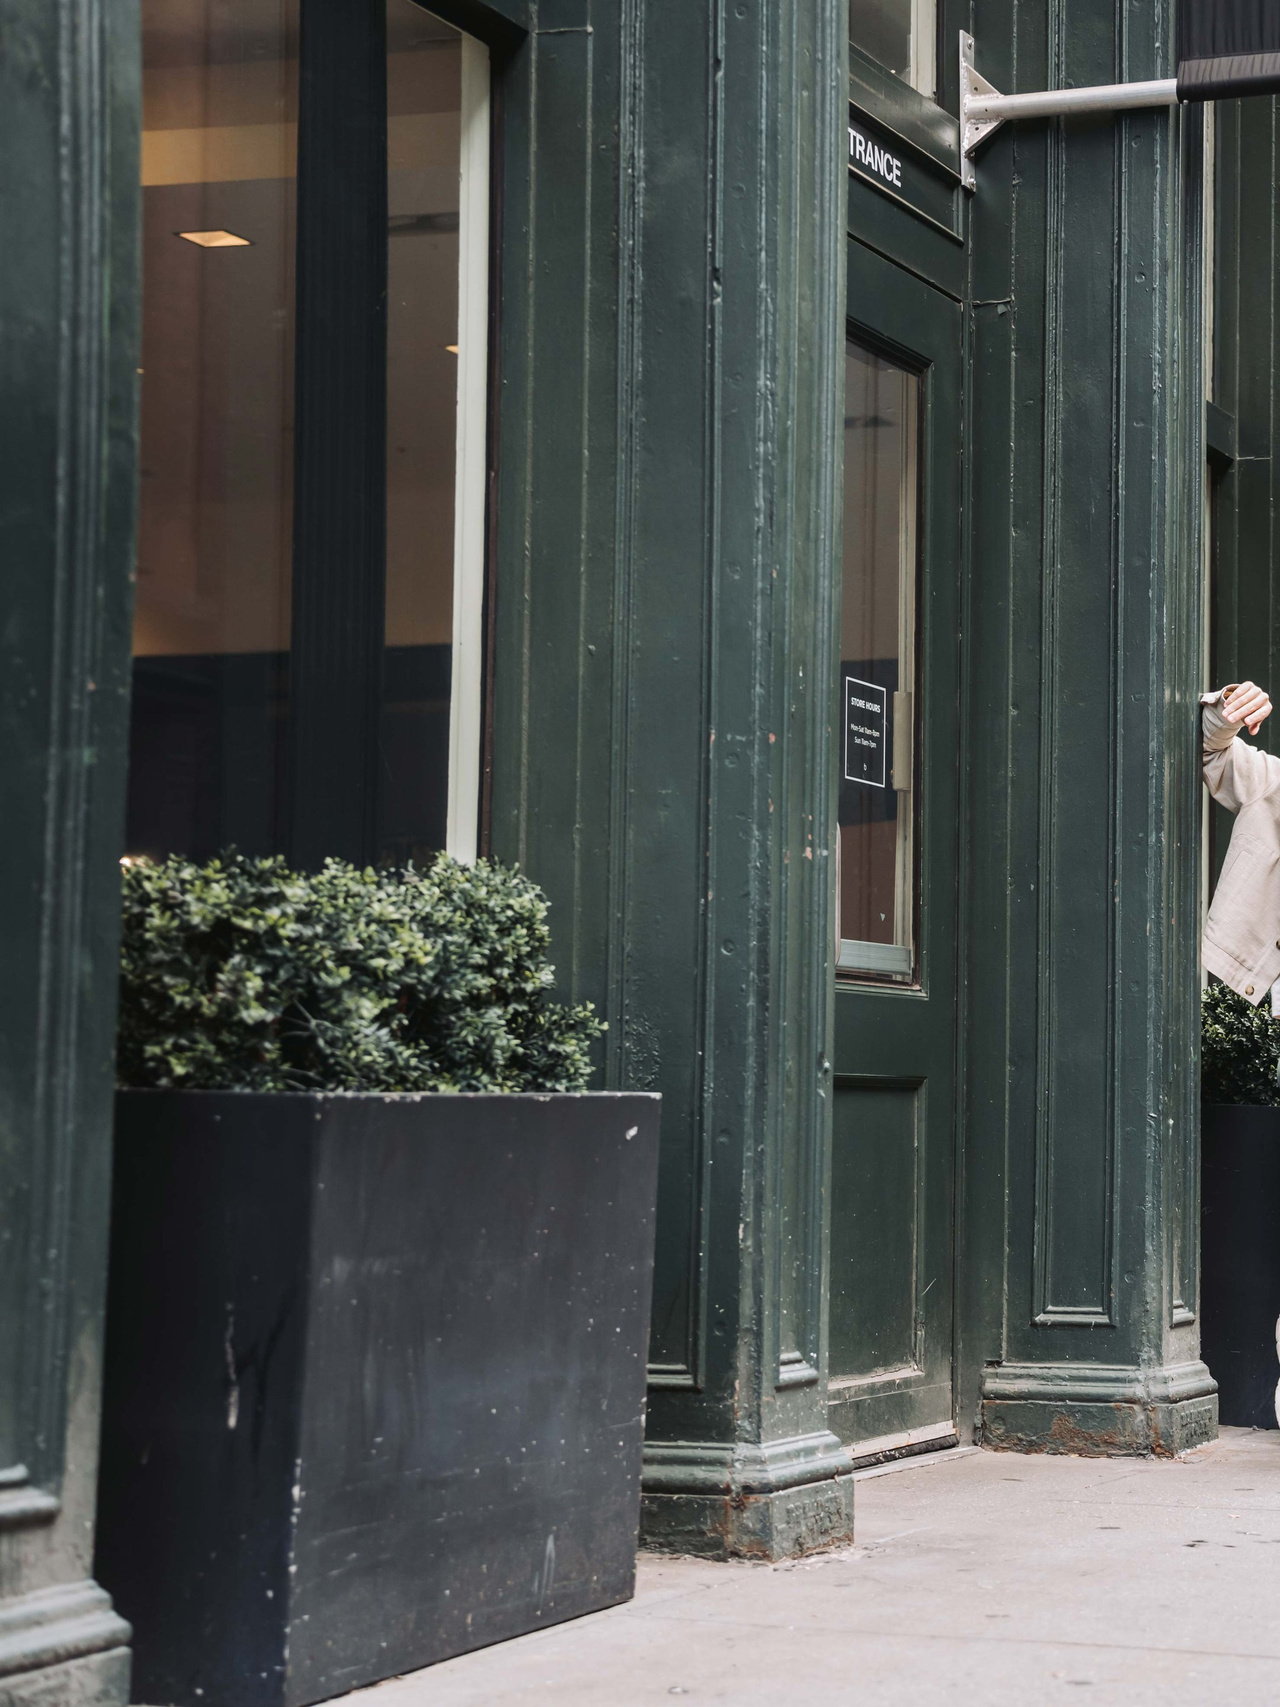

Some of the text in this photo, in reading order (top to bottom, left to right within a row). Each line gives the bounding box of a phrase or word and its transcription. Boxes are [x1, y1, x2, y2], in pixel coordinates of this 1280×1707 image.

[848, 127, 902, 188] TRANCE
[851, 697, 881, 713] STORE HOURS
[854, 736, 862, 744] Sun
